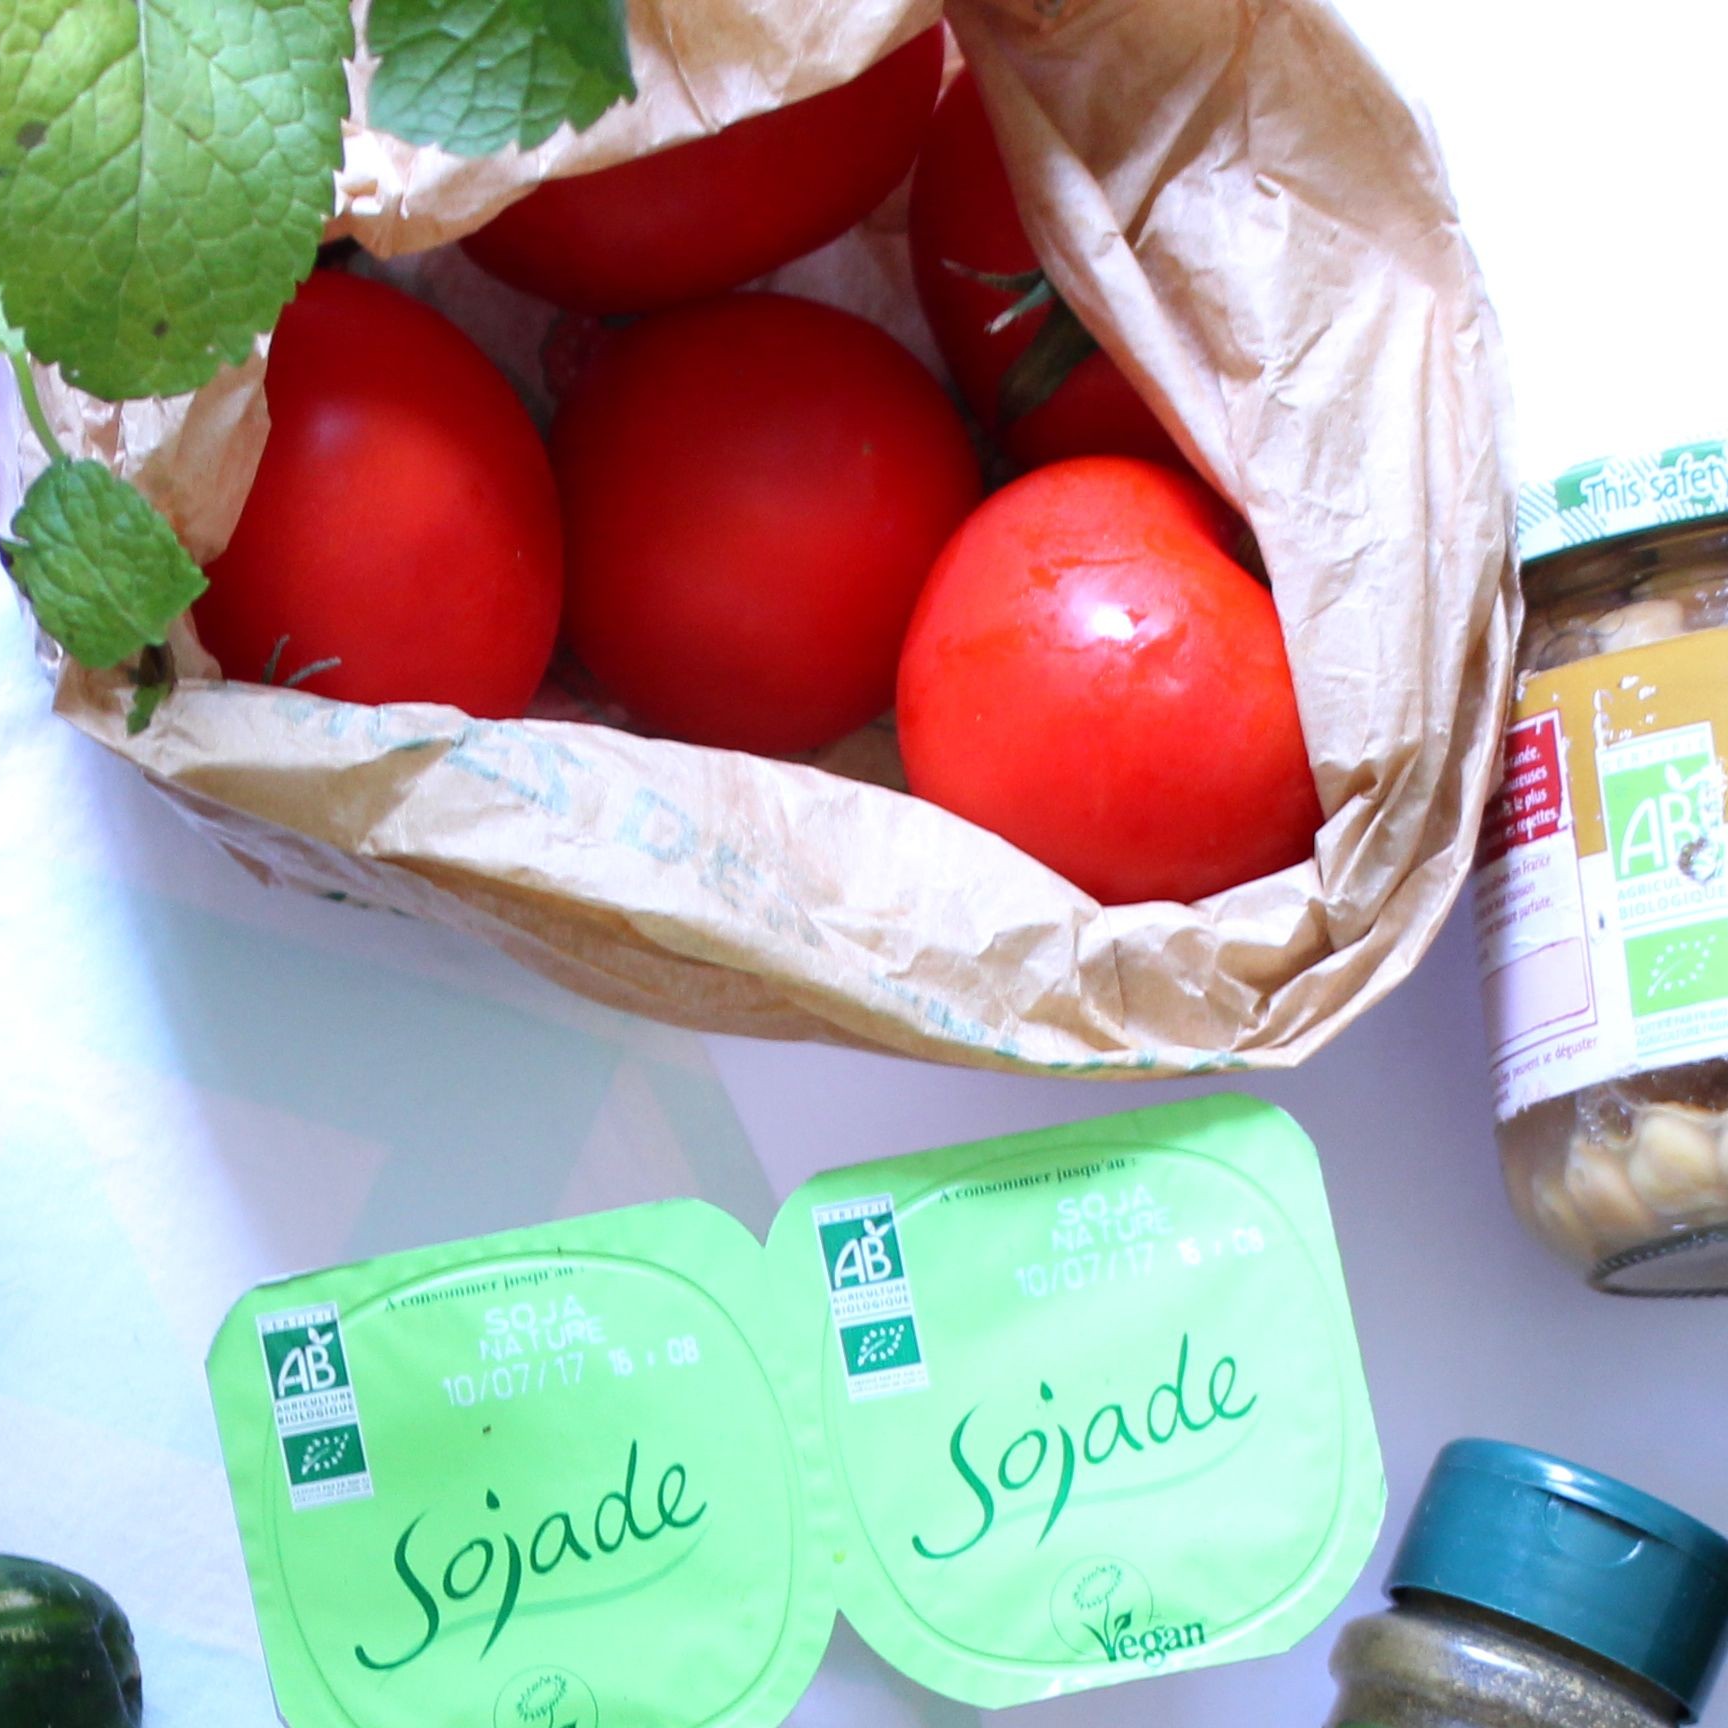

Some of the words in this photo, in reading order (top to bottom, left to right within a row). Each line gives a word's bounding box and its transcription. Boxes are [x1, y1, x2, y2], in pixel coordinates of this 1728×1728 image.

[1586, 479, 1641, 512] This
[955, 1172, 1052, 1200] consommer
[1056, 1157, 1126, 1183] jusqu'au
[1052, 1205, 1173, 1253] NATURE
[1057, 1183, 1156, 1227] SOJA
[832, 1236, 892, 1290] AB
[1015, 1241, 1154, 1298] 10/07/17
[401, 1280, 498, 1307] consommer
[484, 1291, 586, 1336] SOJA
[479, 1314, 608, 1362] NATURE
[277, 1344, 336, 1396] AB
[442, 1351, 586, 1407] 10/07/17
[667, 1334, 701, 1365] 08
[912, 1332, 1258, 1559] Sojade
[355, 1438, 708, 1671] Sojade
[1081, 1608, 1206, 1667] Vegan
